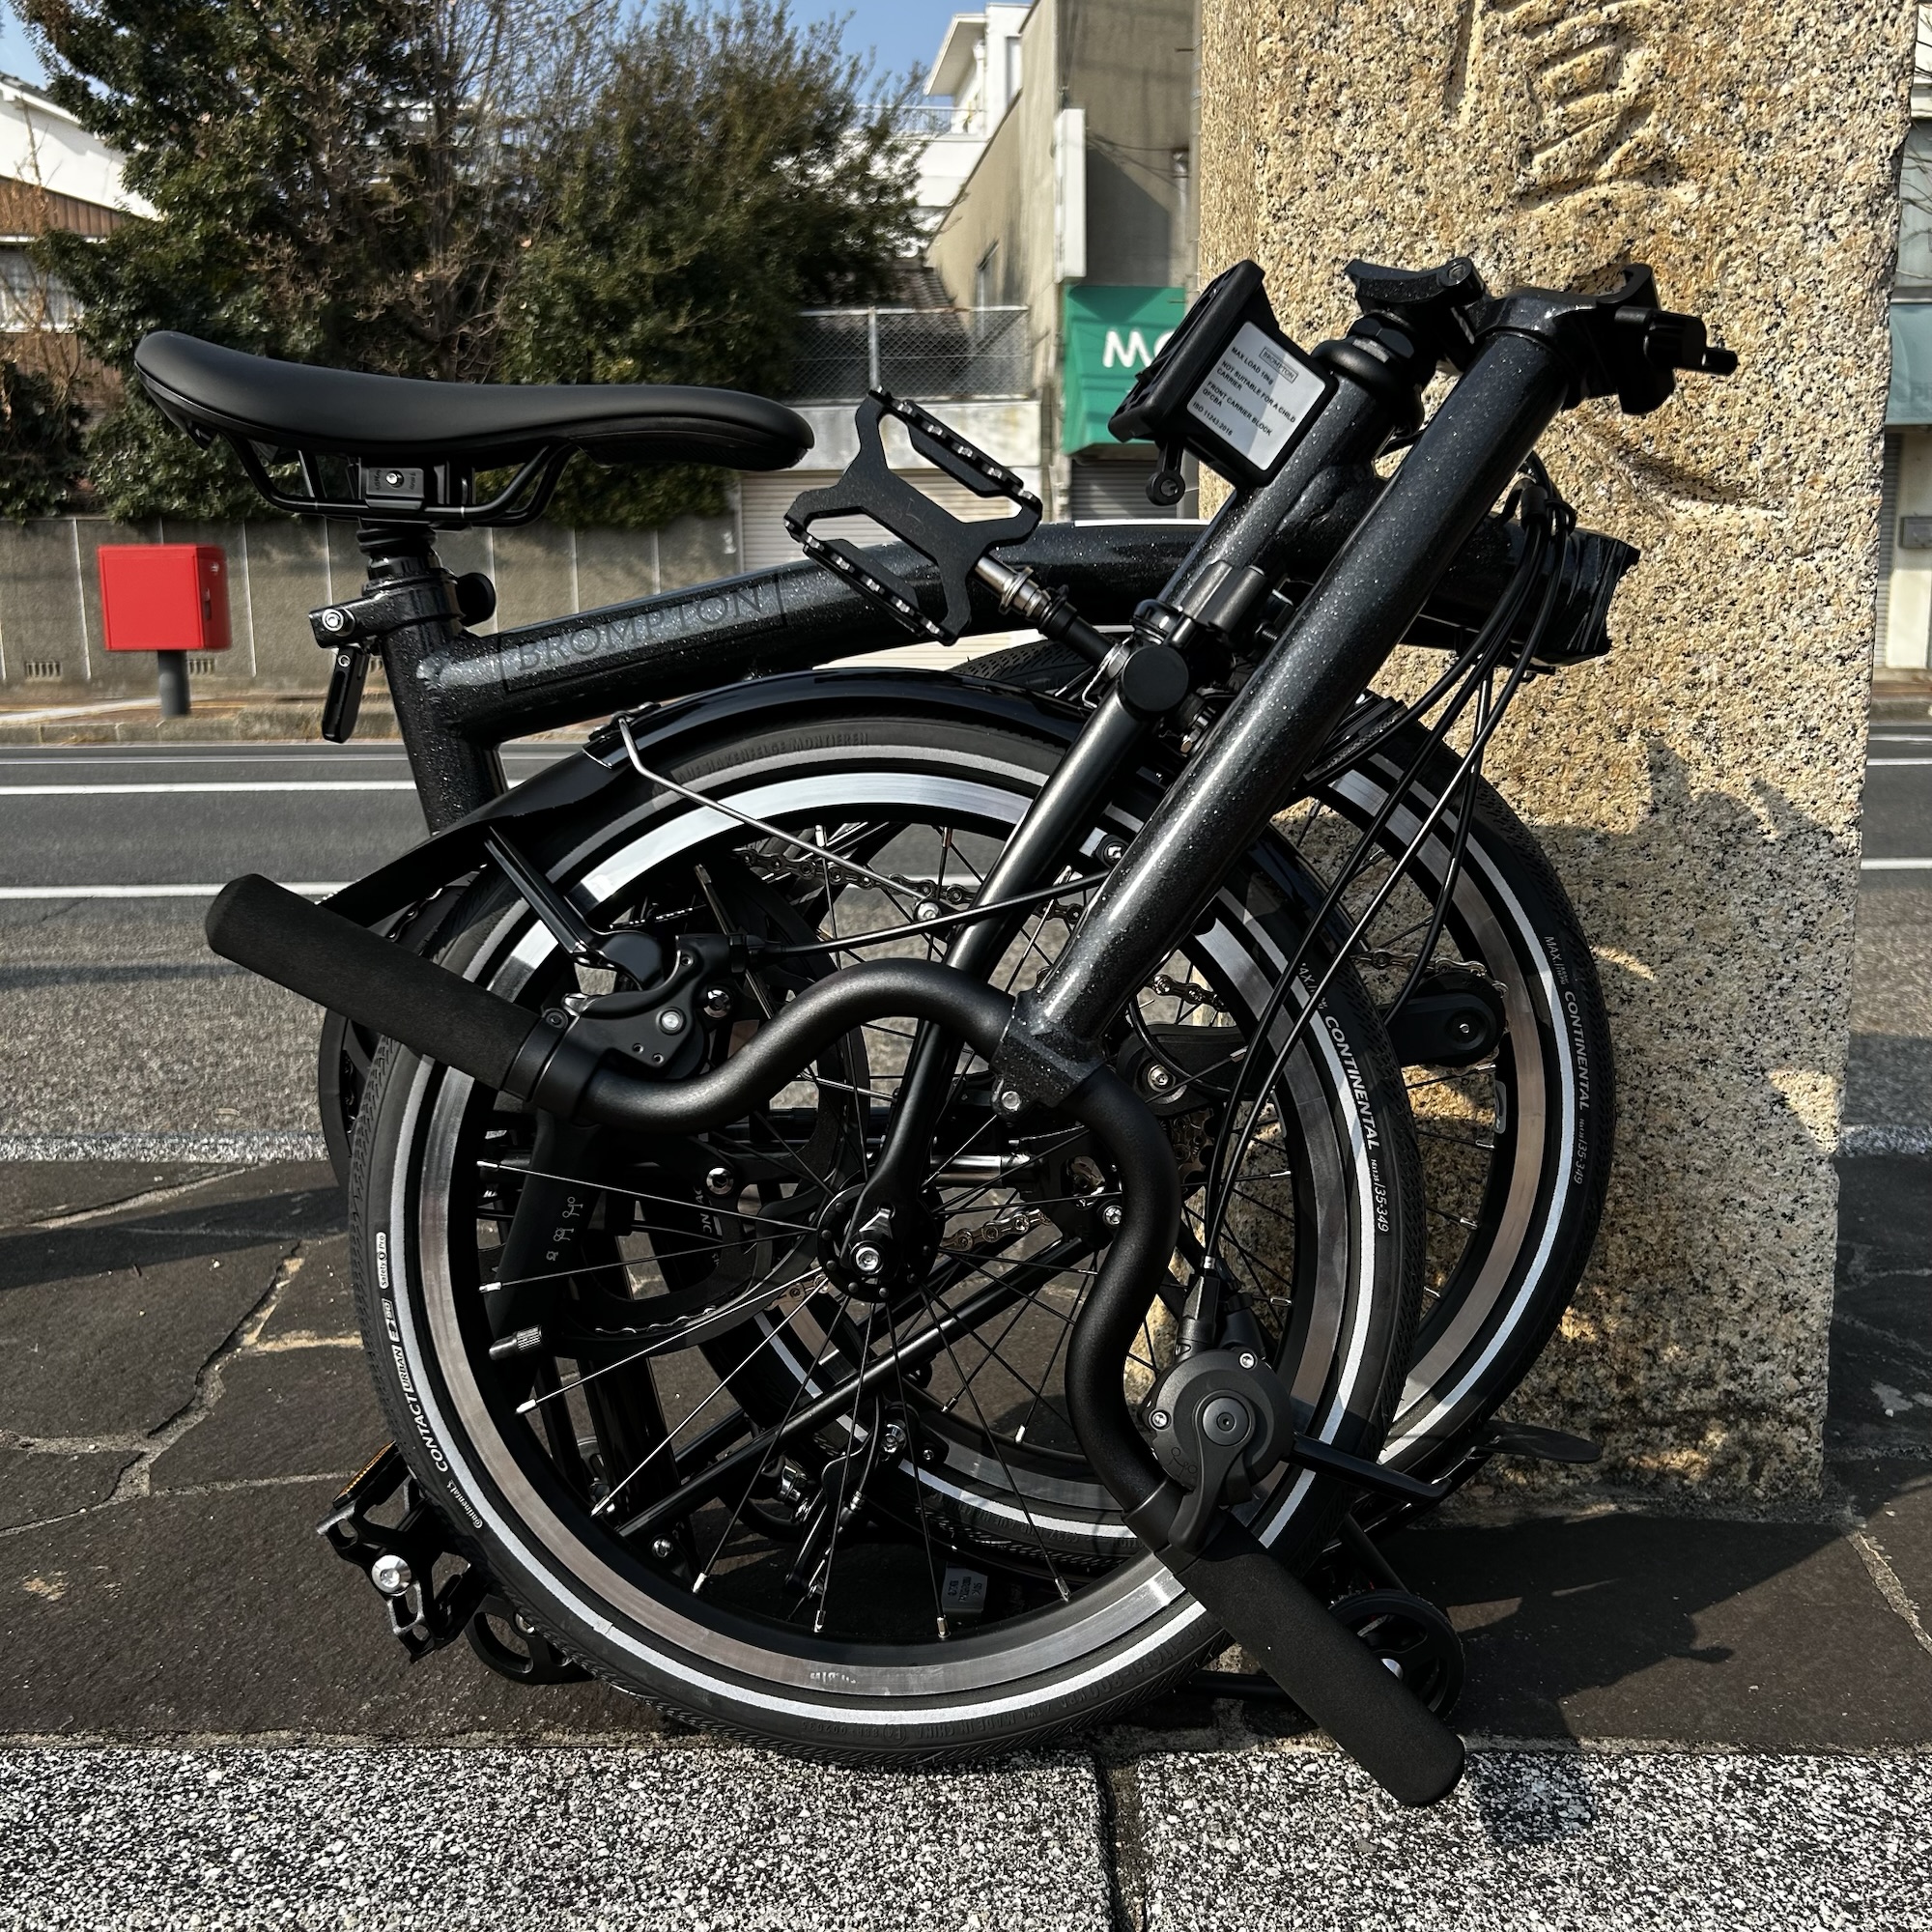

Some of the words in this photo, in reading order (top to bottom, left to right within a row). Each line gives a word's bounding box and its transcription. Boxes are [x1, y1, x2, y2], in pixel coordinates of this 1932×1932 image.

[1217, 367, 1243, 391] CARRIER
[1231, 346, 1245, 360] MAX
[1244, 356, 1263, 374] LOAD
[1263, 351, 1295, 380] BROMPTON
[1193, 400, 1206, 412] ISO
[1203, 387, 1224, 407] QFCBA
[1208, 381, 1228, 399] FRONT
[1226, 396, 1253, 420] CARRIER
[1251, 416, 1273, 436] BLOCK
[1221, 359, 1236, 374] NOT
[1234, 370, 1263, 395] SUITABLE
[1261, 391, 1275, 406] FOR
[1278, 405, 1297, 423] CHILD
[518, 583, 762, 670] BROMPTON
[1562, 988, 1590, 1110] CONTINENTAL
[1324, 1015, 1380, 1150] CONTINENTAL
[393, 1347, 412, 1389] URBAN
[406, 1392, 447, 1472] CONTACT
[916, 1722, 954, 1739] CHINA
